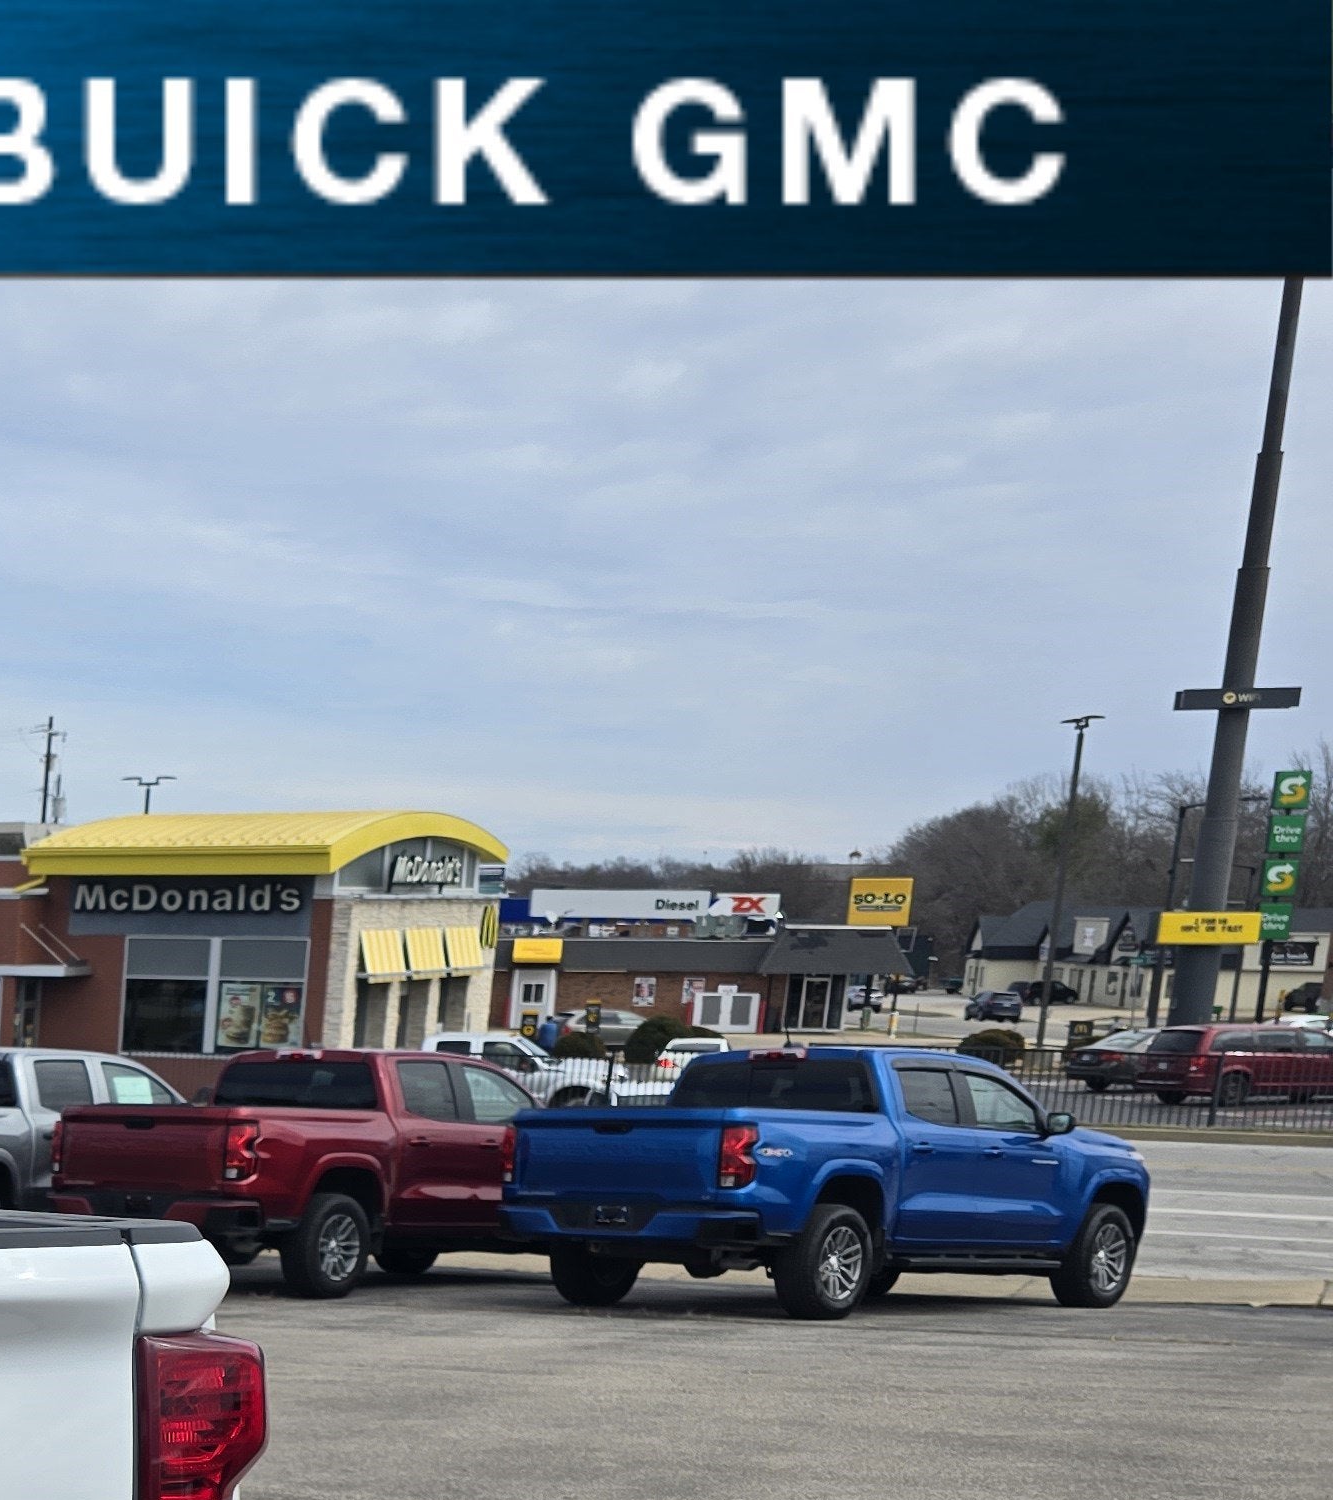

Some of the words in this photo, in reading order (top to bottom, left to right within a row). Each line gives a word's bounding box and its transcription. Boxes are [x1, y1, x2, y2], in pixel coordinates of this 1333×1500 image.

[1273, 825, 1302, 834] Drive
[1275, 834, 1299, 843] thru
[392, 855, 462, 883] McDonald's
[73, 883, 301, 913] McDonald's
[853, 892, 907, 905] SO-LO
[654, 899, 700, 911] Diesel
[732, 897, 766, 914] ZX
